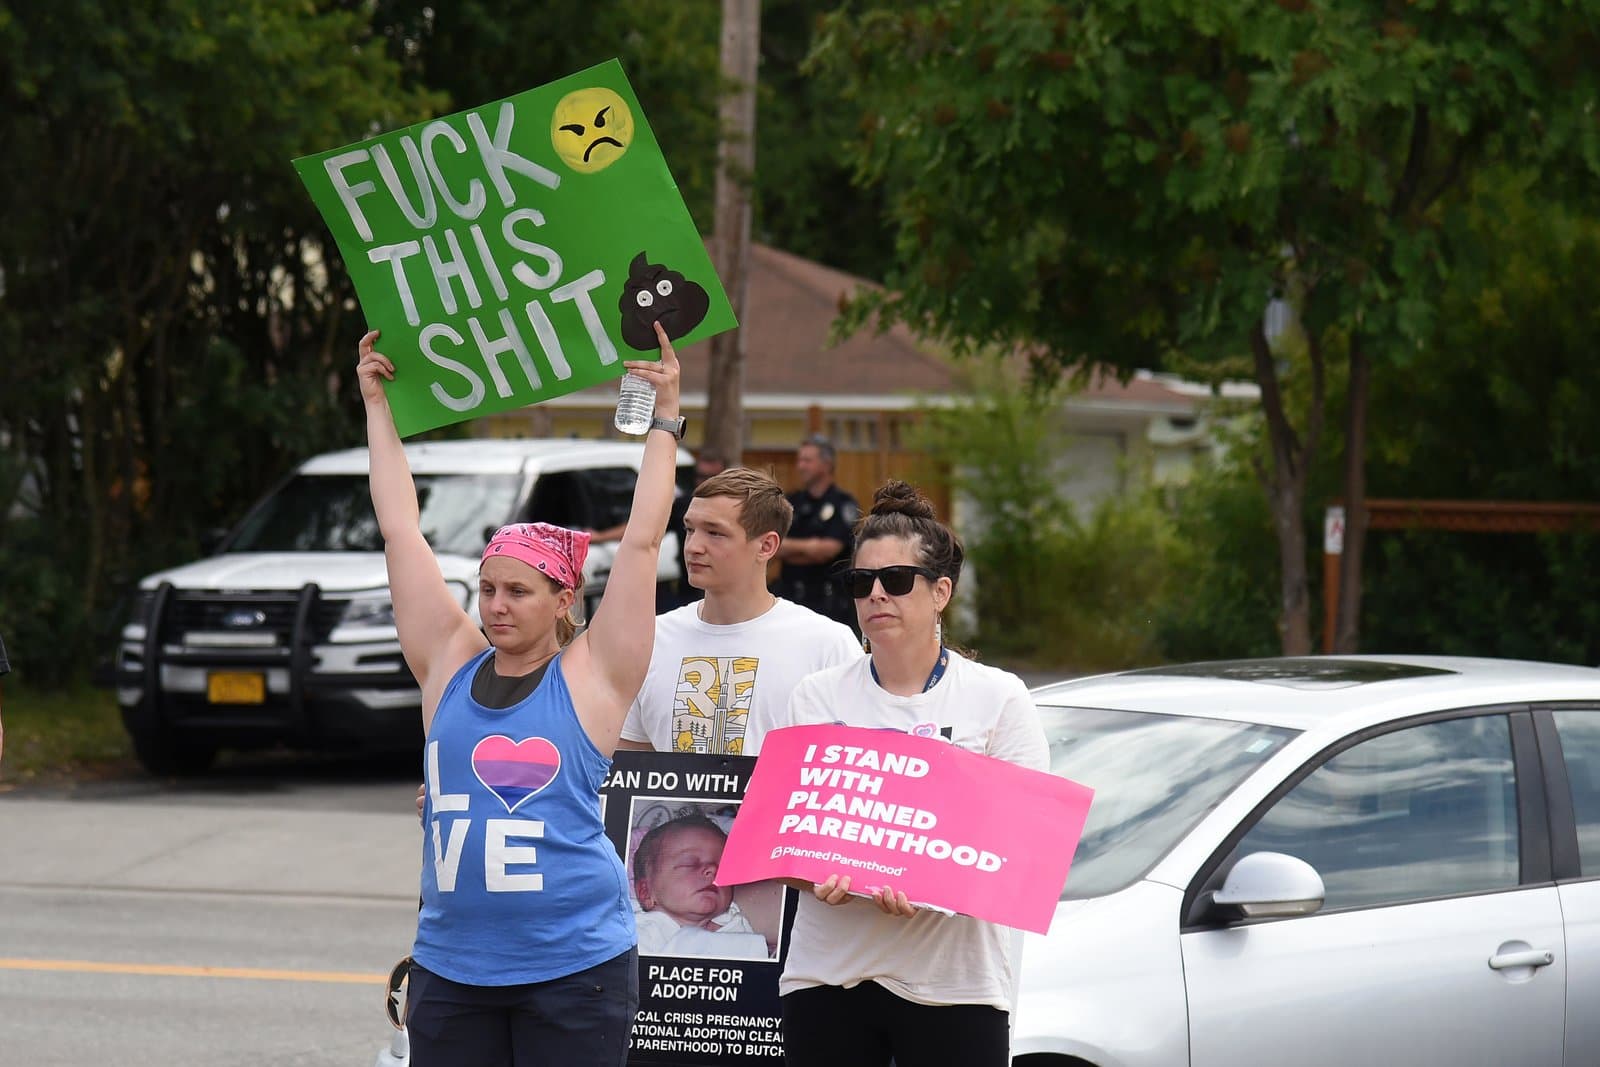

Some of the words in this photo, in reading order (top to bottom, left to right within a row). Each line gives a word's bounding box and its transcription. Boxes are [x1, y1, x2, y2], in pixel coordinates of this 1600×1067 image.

[324, 102, 561, 242] FUCK
[367, 208, 563, 326] THIS
[418, 269, 618, 412] SHIT
[803, 744, 818, 763] I
[821, 745, 930, 778] STAND
[647, 771, 679, 791] DO
[685, 773, 739, 793] WITH
[800, 767, 884, 795] WITH
[786, 791, 938, 830] PLANNED
[782, 846, 831, 861] Planned
[649, 965, 704, 982] PLACE
[708, 968, 743, 984] FOR
[650, 983, 737, 1001] ADOPTION
[634, 1010, 661, 1023] CAL
[664, 1012, 703, 1025] CRISIS
[706, 1014, 782, 1029] PREGNANCY
[683, 1027, 746, 1041] ADOPTION
[636, 1039, 723, 1056] PARENTHOOD)
[726, 1043, 743, 1055] TO
